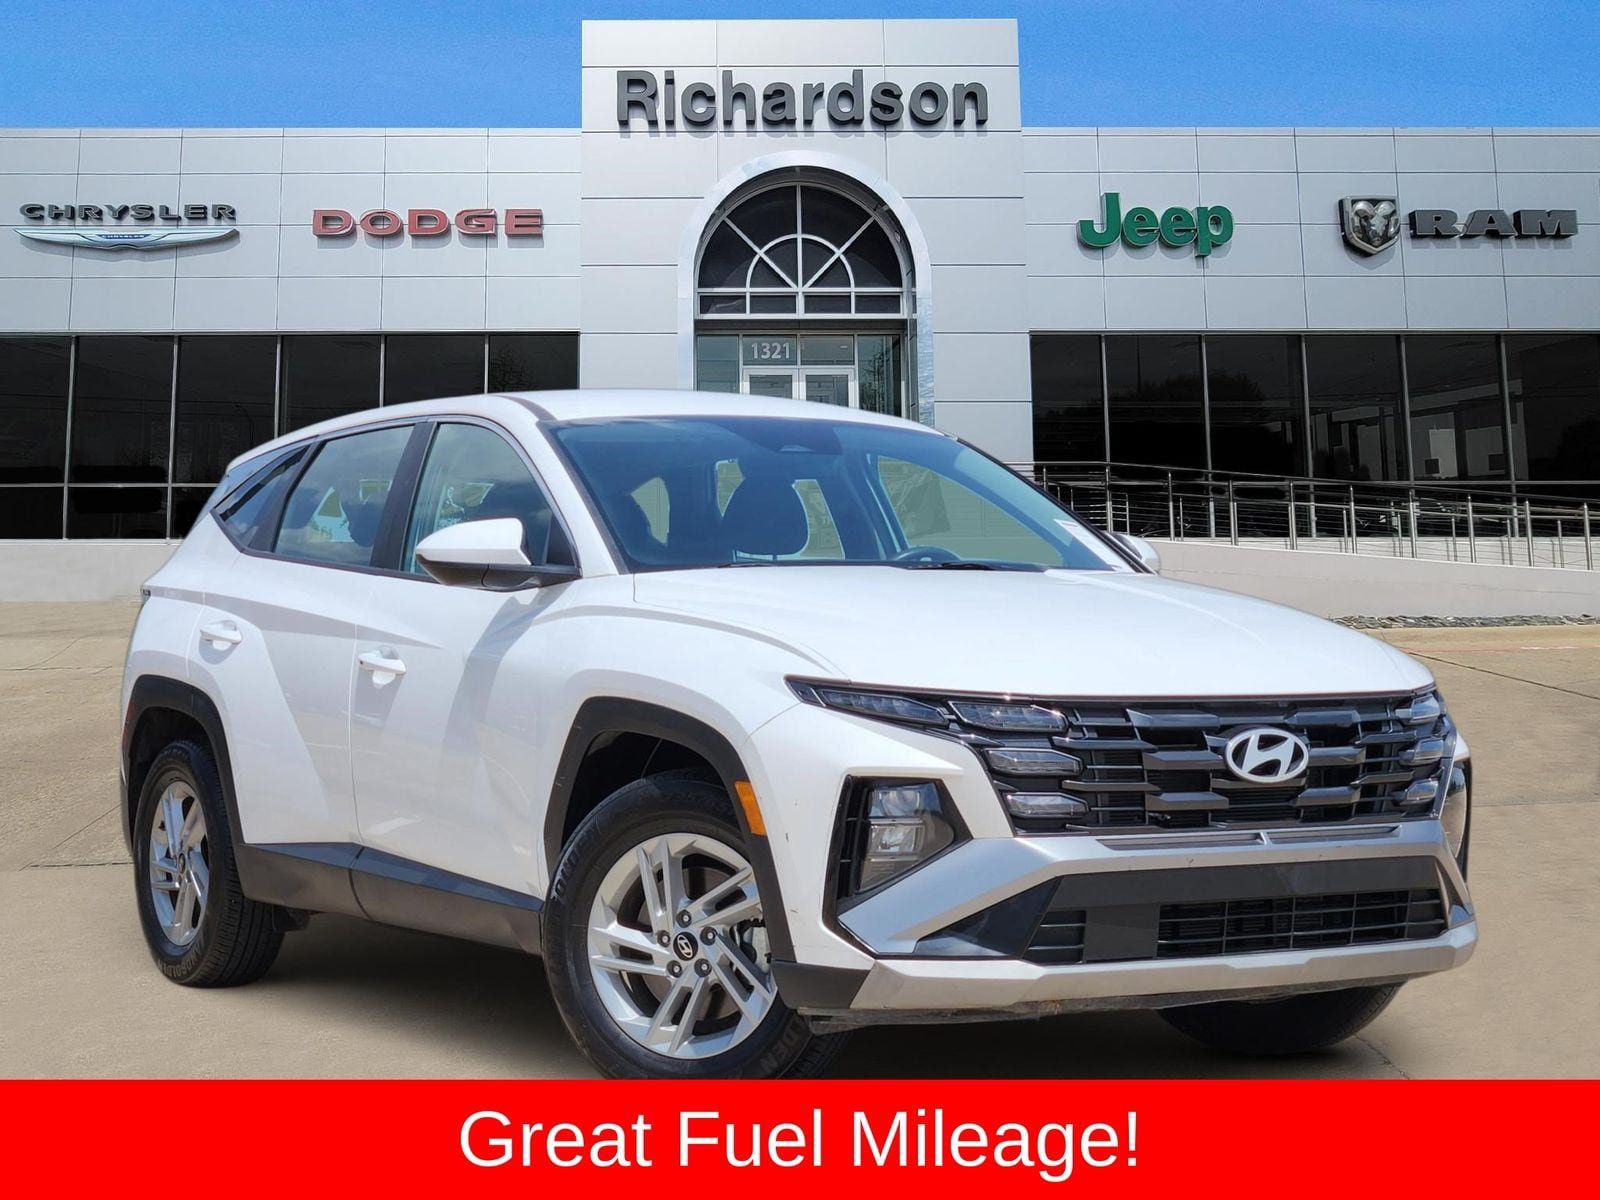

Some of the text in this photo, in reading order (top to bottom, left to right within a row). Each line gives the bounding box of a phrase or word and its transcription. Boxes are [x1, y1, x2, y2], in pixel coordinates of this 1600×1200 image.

[616, 69, 988, 126] Richardson
[19, 203, 236, 221] CHRYSLER
[312, 208, 544, 236] DODGE
[1077, 192, 1234, 257] Jeep
[1408, 209, 1578, 239] RAM
[751, 342, 790, 359] 1321
